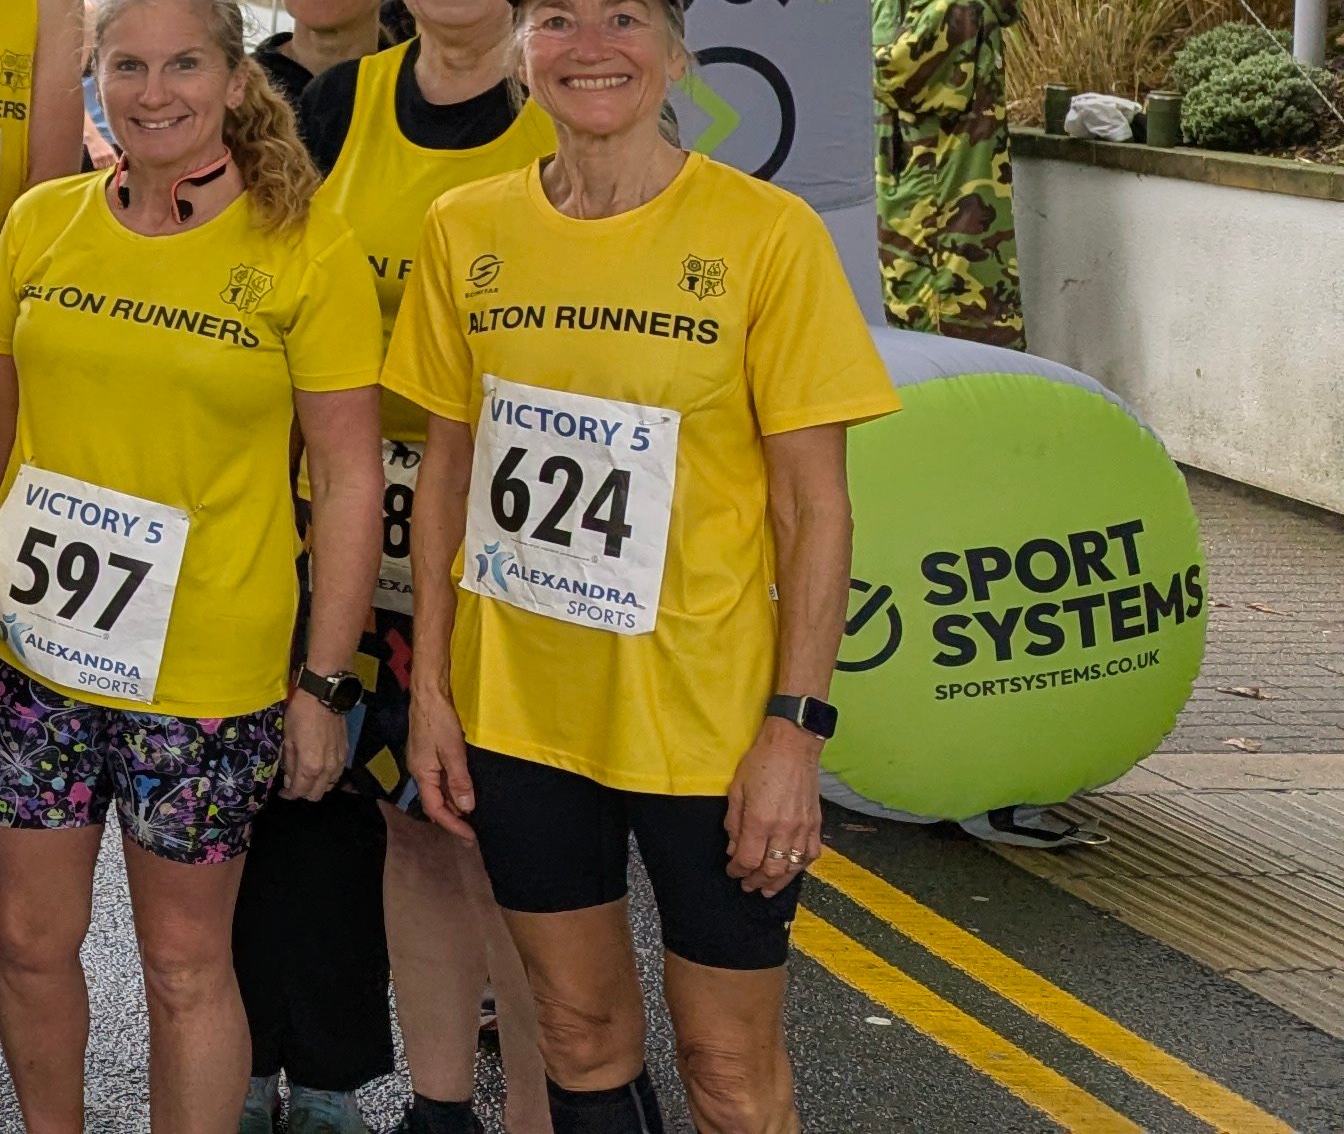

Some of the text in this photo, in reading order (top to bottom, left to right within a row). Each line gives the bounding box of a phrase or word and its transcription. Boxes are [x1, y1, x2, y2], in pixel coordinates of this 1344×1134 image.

[109, 298, 260, 348] RUNNERS
[468, 305, 720, 345] ALTON RUNNERS
[490, 398, 651, 452] VICTORY 5
[25, 483, 164, 545] VICTORY 5
[490, 445, 633, 559] 624
[8, 526, 154, 633] 597
[506, 562, 639, 608] ALEXANDRA
[920, 518, 1145, 607] SPORT
[566, 599, 636, 629] SPORTS
[931, 563, 1204, 667] SYSTEMS
[24, 633, 141, 681] ALEXANDRA
[77, 671, 139, 696] SPORTS
[934, 648, 1161, 702] SPORTSYSTEMS.CO.UK
